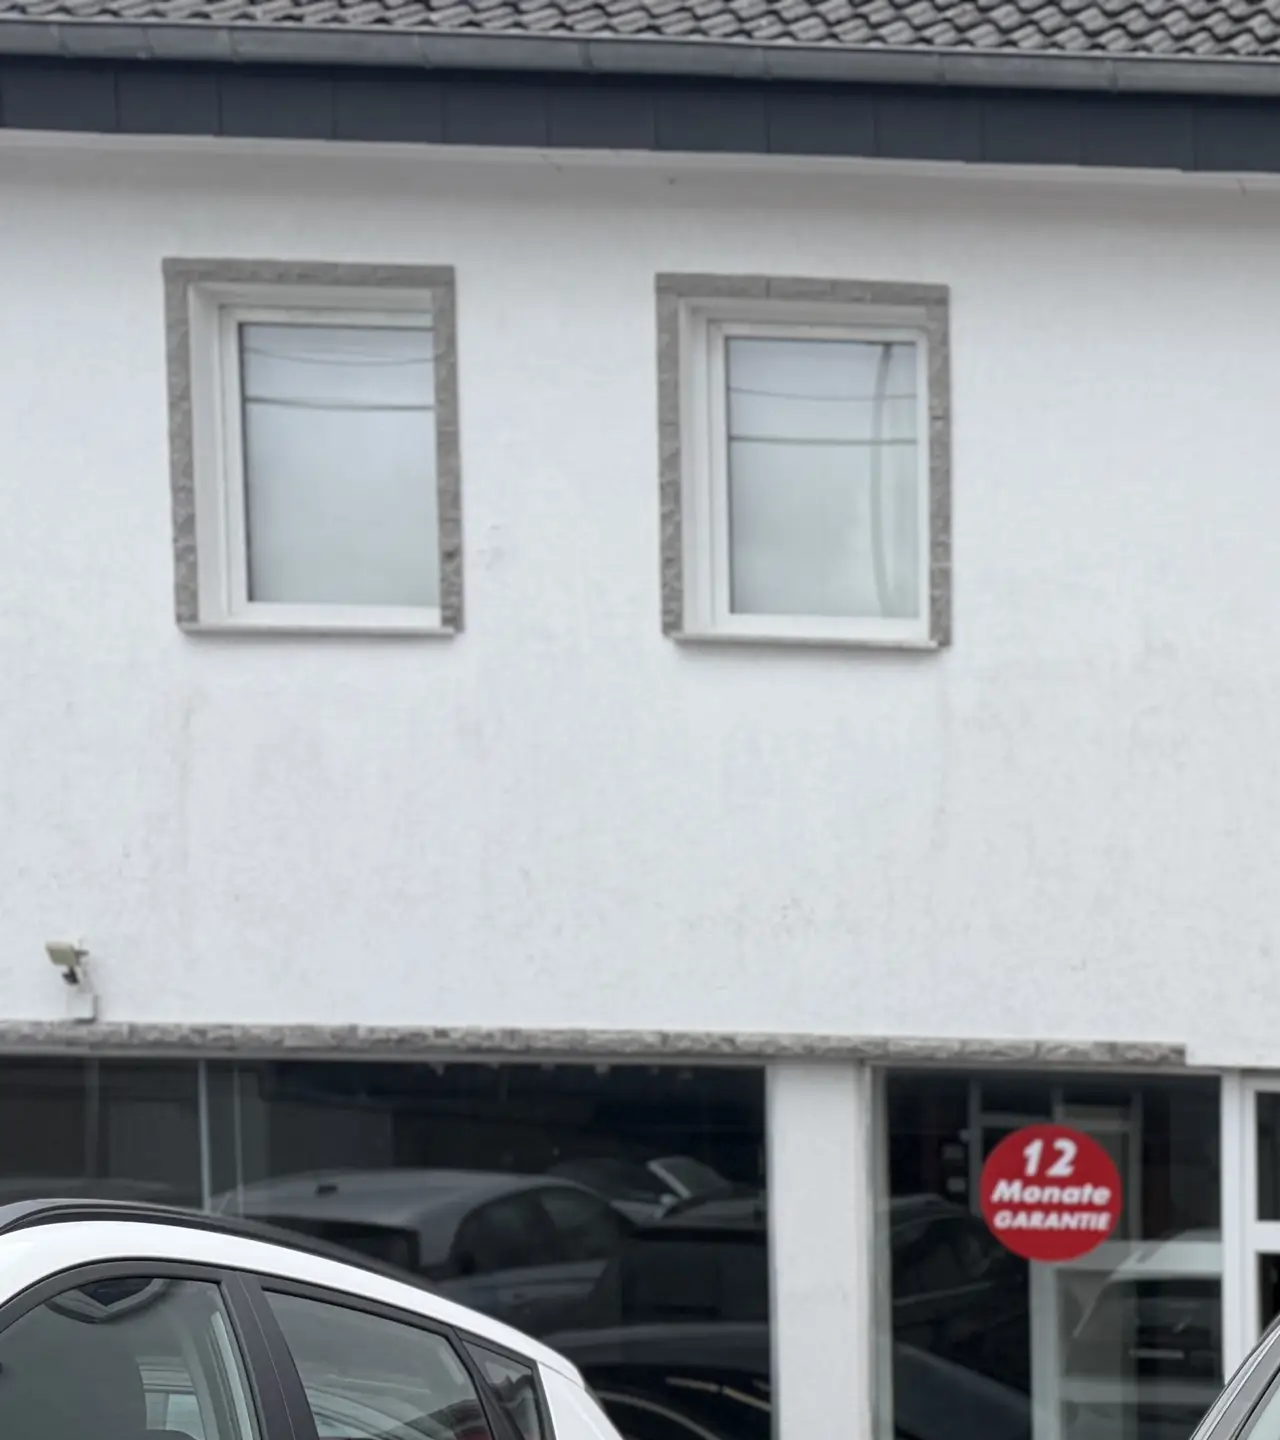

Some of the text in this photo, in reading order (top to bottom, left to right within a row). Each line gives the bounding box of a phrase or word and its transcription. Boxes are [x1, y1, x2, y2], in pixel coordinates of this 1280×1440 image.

[1023, 1138, 1077, 1177] 12
[991, 1179, 1111, 1206] Monate
[993, 1209, 1111, 1232] GARANTIE
